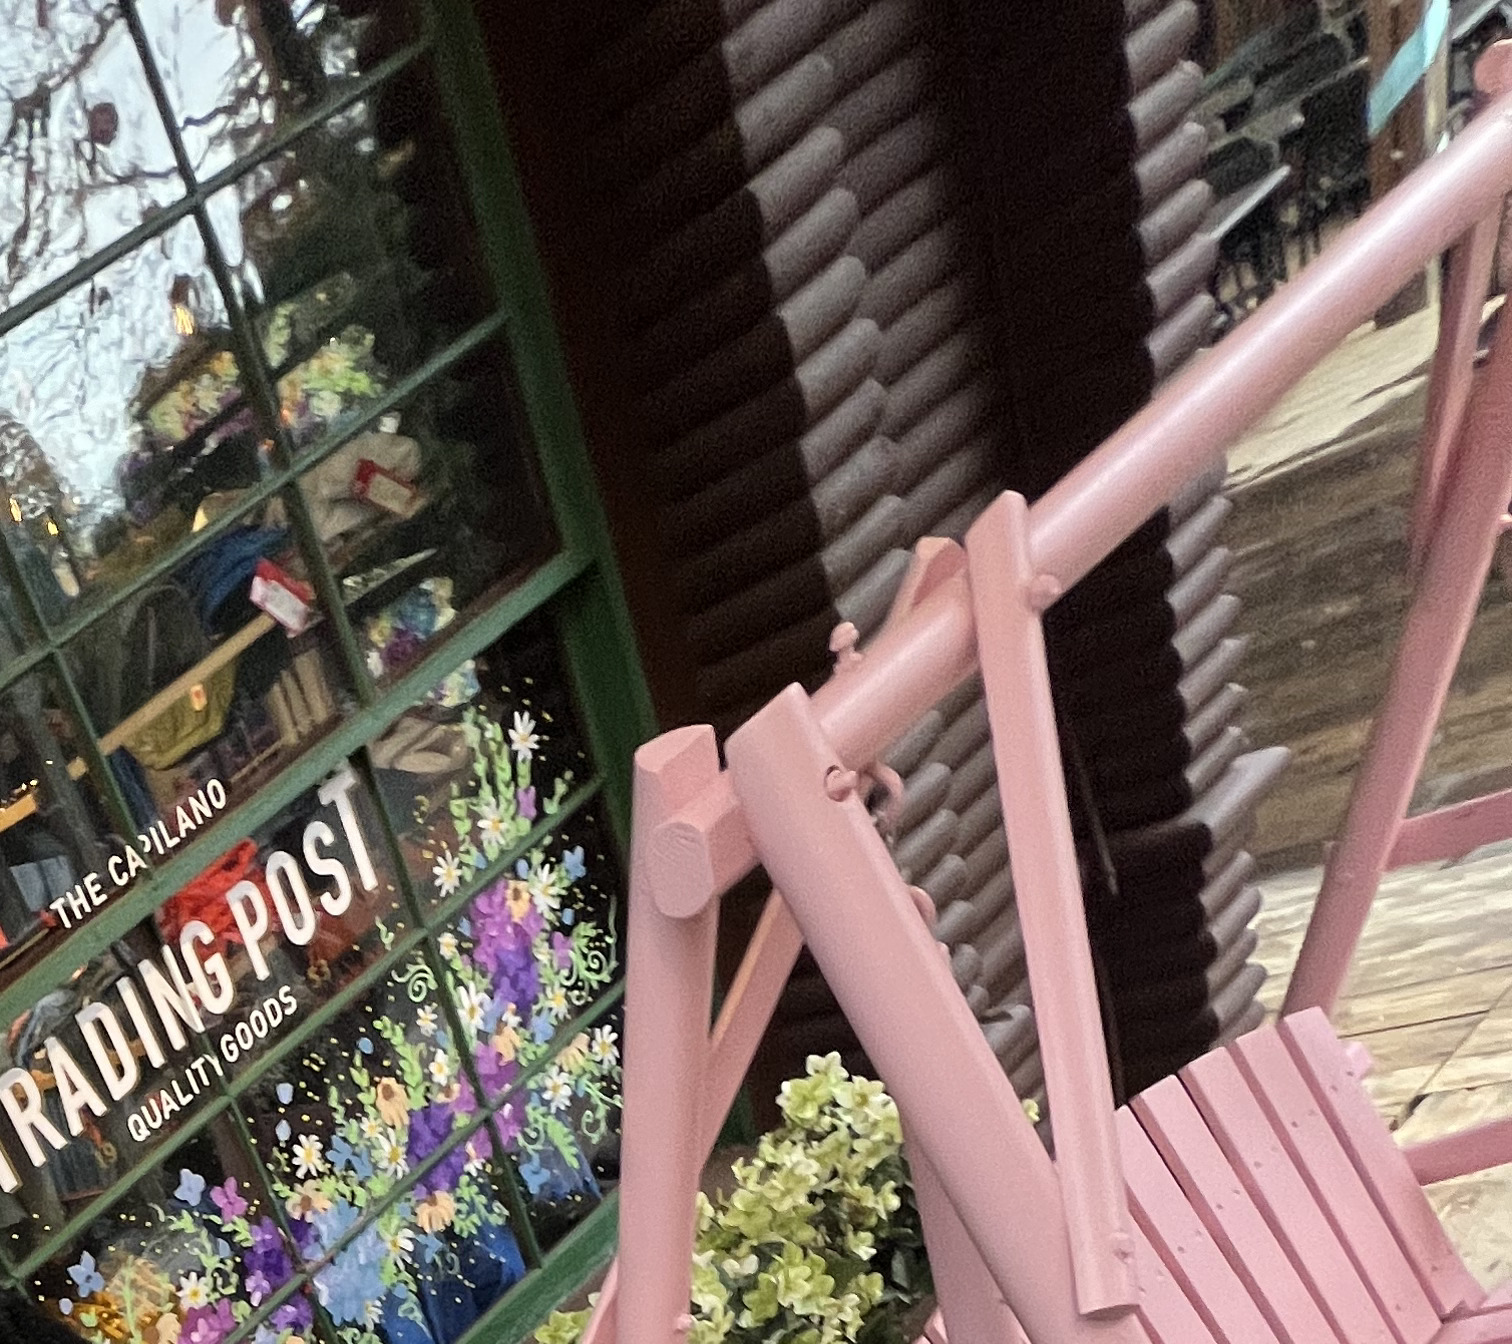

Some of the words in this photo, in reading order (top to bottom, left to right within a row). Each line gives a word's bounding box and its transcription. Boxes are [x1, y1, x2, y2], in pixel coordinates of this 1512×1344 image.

[50, 873, 108, 928] THE
[226, 768, 378, 981] POST
[127, 1054, 224, 1142] QUALITY
[220, 985, 297, 1062] GOODS
